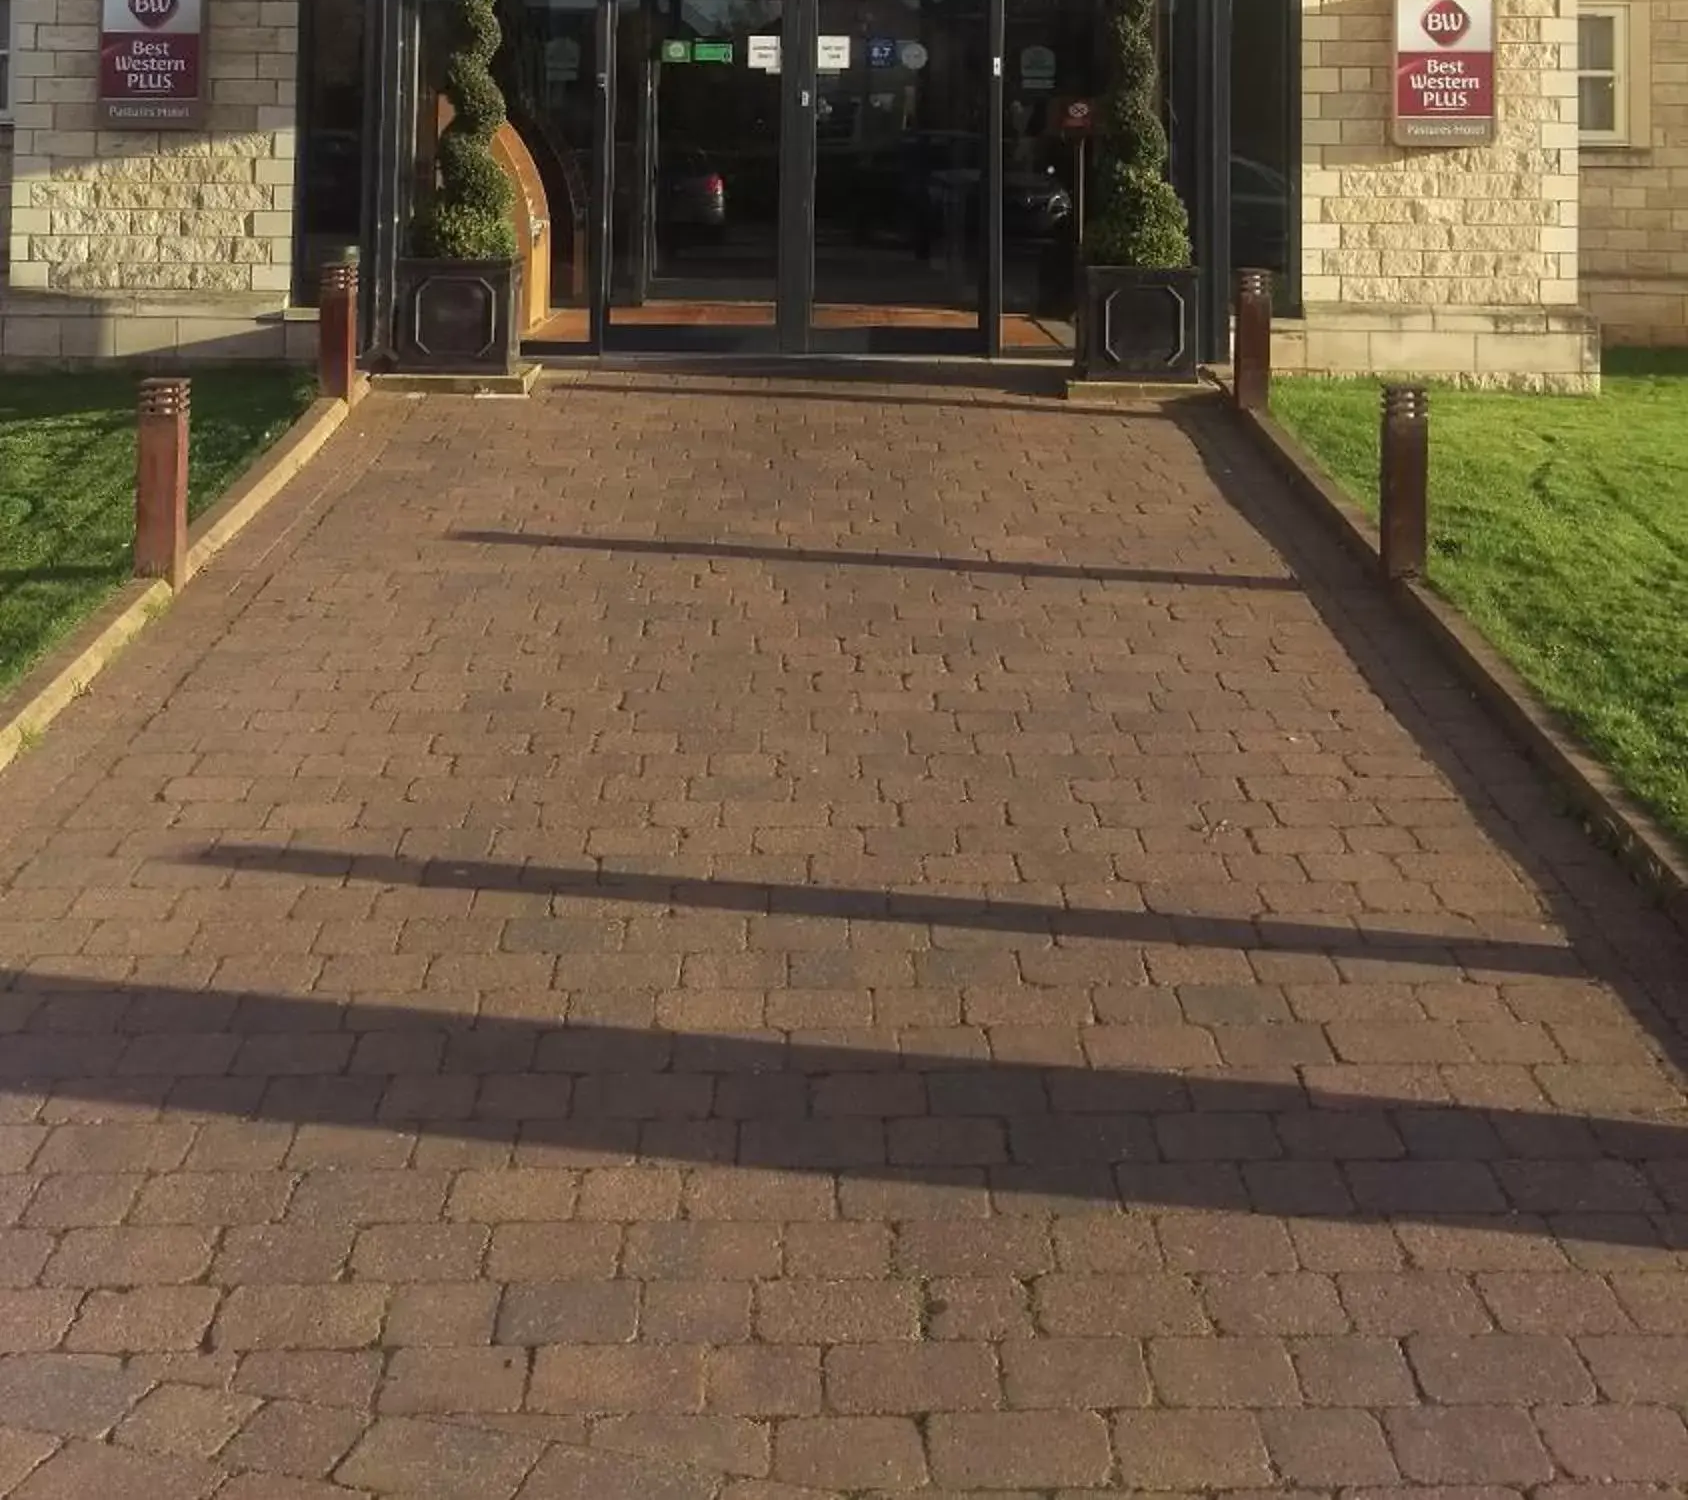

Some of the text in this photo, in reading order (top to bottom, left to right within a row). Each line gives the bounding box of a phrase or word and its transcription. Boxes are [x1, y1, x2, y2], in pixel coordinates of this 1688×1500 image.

[1427, 13, 1463, 31] BW
[133, 41, 170, 55] Best
[115, 56, 185, 71] Western
[1427, 59, 1464, 74] Best
[127, 73, 173, 89] PLUS
[1410, 75, 1479, 89] Western
[1423, 91, 1468, 107] PLUS
